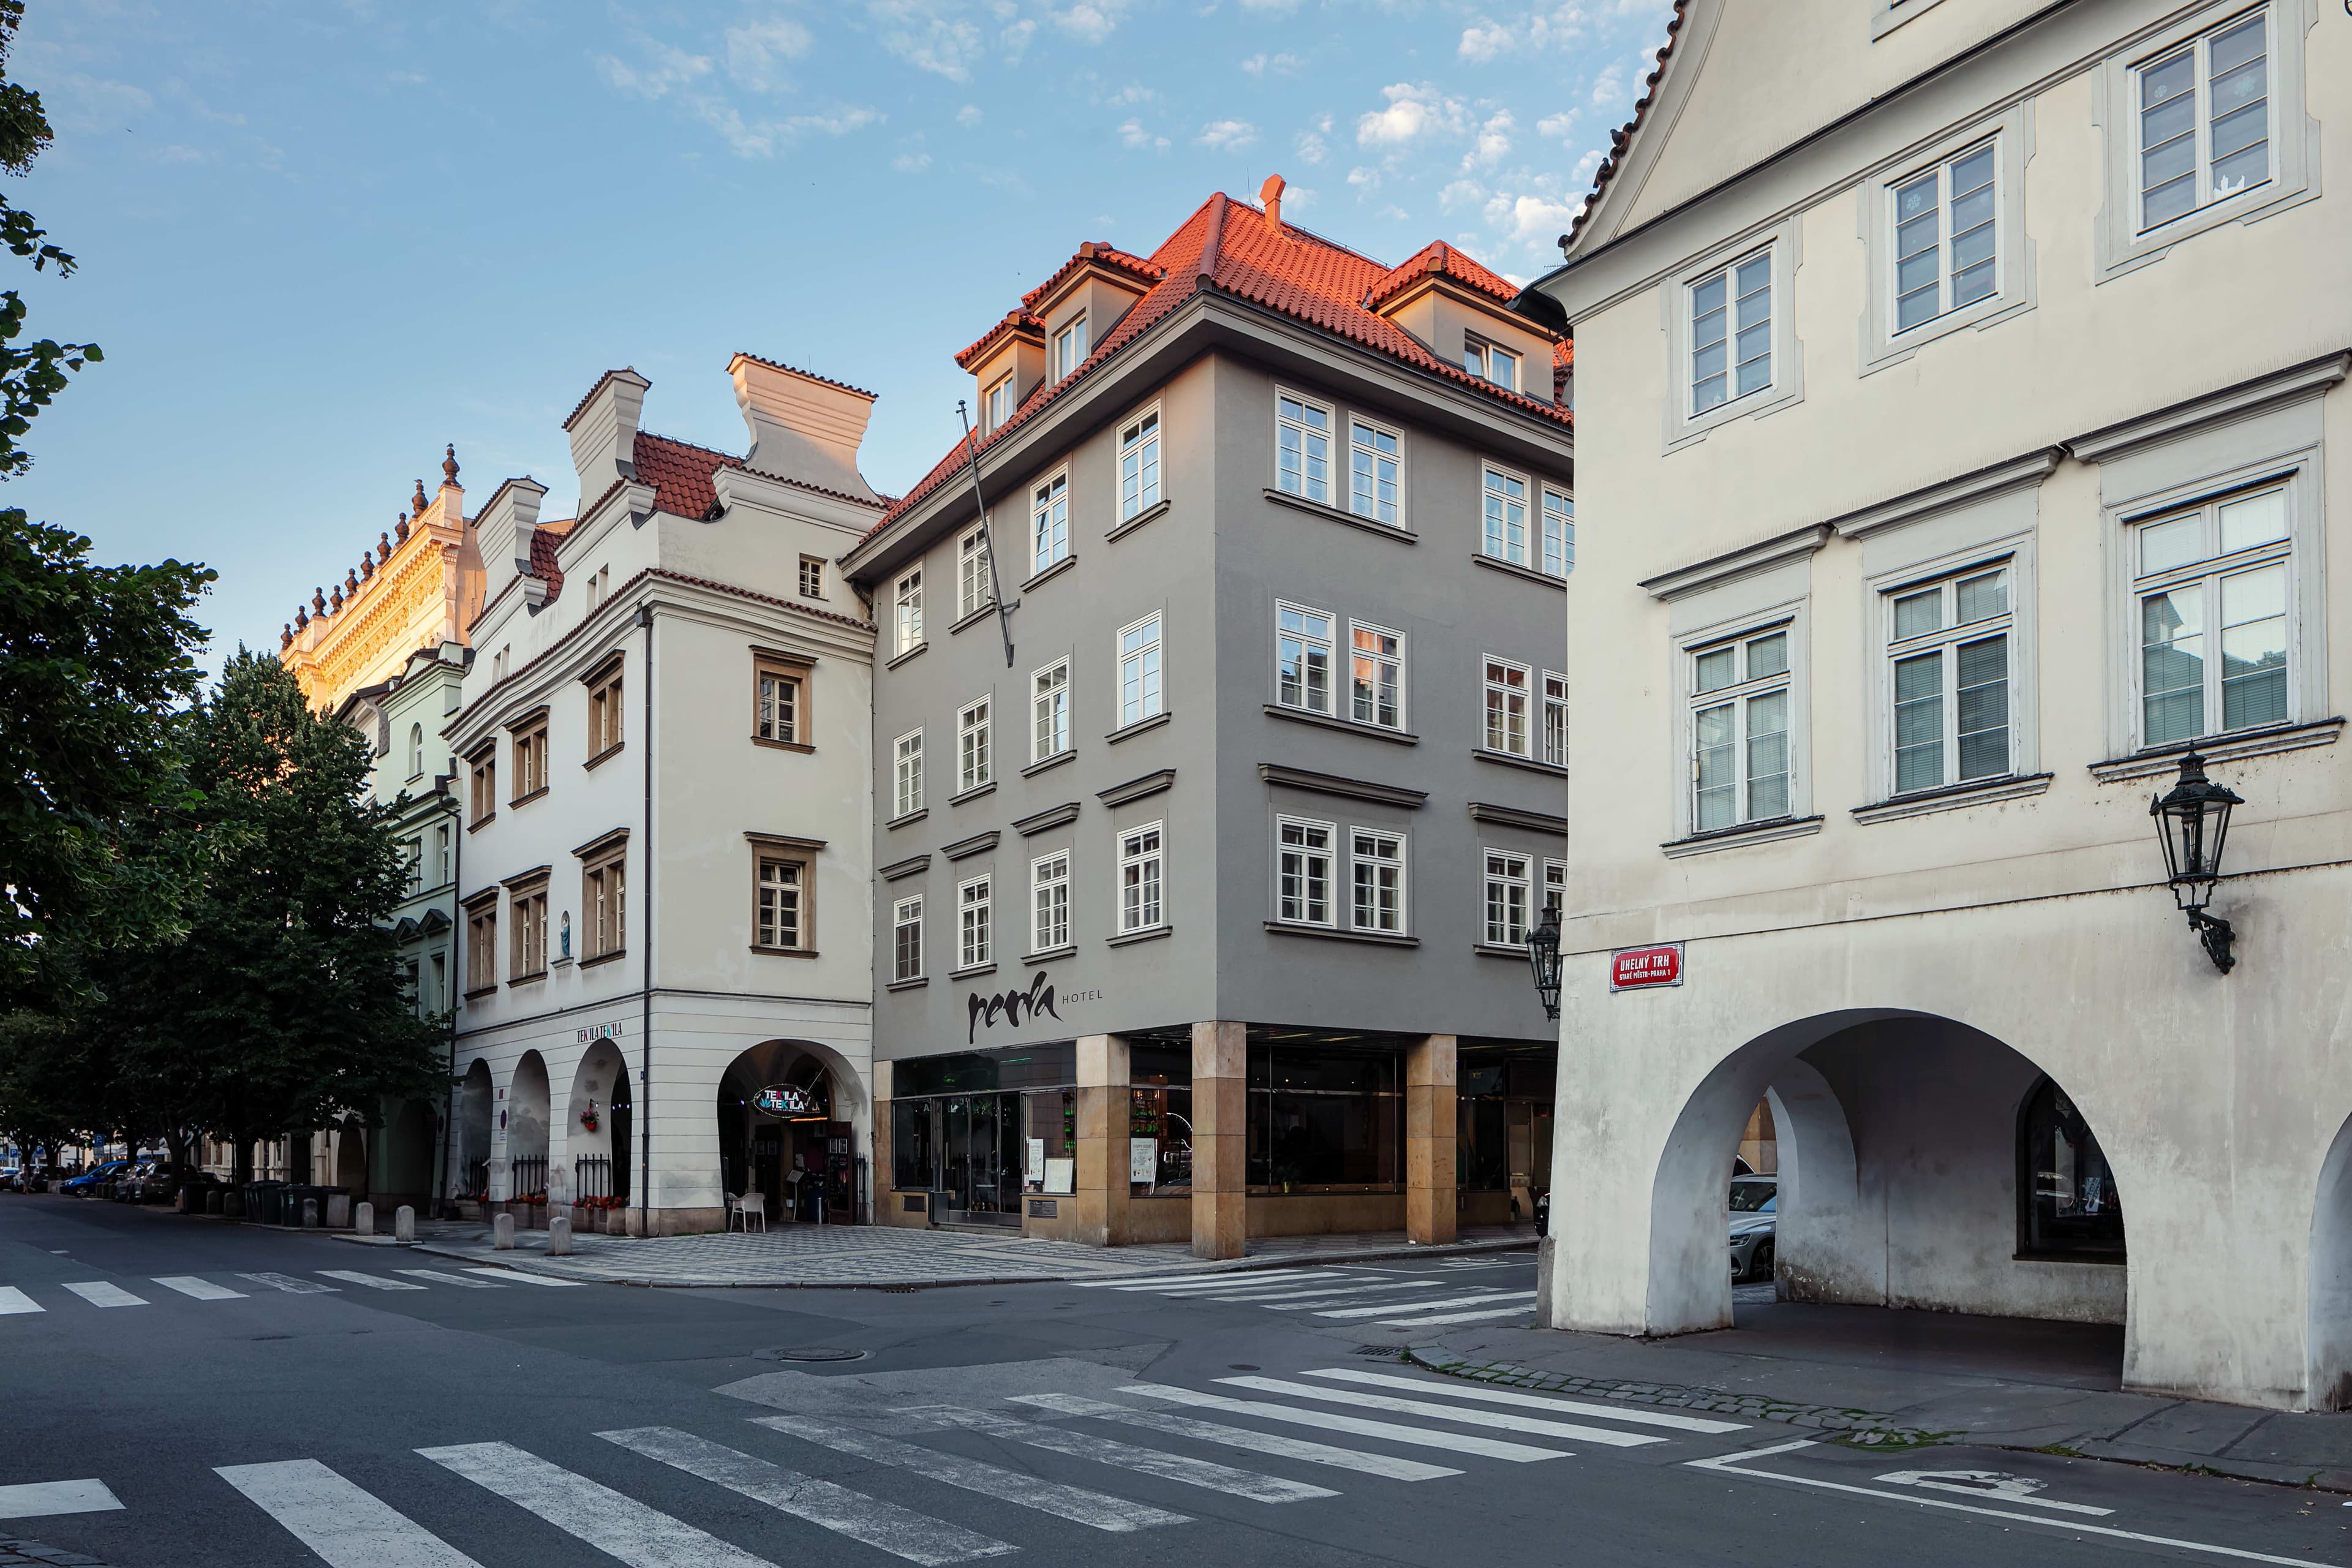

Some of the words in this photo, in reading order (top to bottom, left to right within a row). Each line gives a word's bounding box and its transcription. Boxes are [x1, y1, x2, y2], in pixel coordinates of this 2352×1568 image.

[1620, 954, 1649, 971] UHELNÝ
[1653, 955, 1670, 968] TRH
[1619, 971, 1632, 981] STARÉ
[968, 971, 1065, 1044] perla
[1063, 990, 1102, 1005] HOTEL
